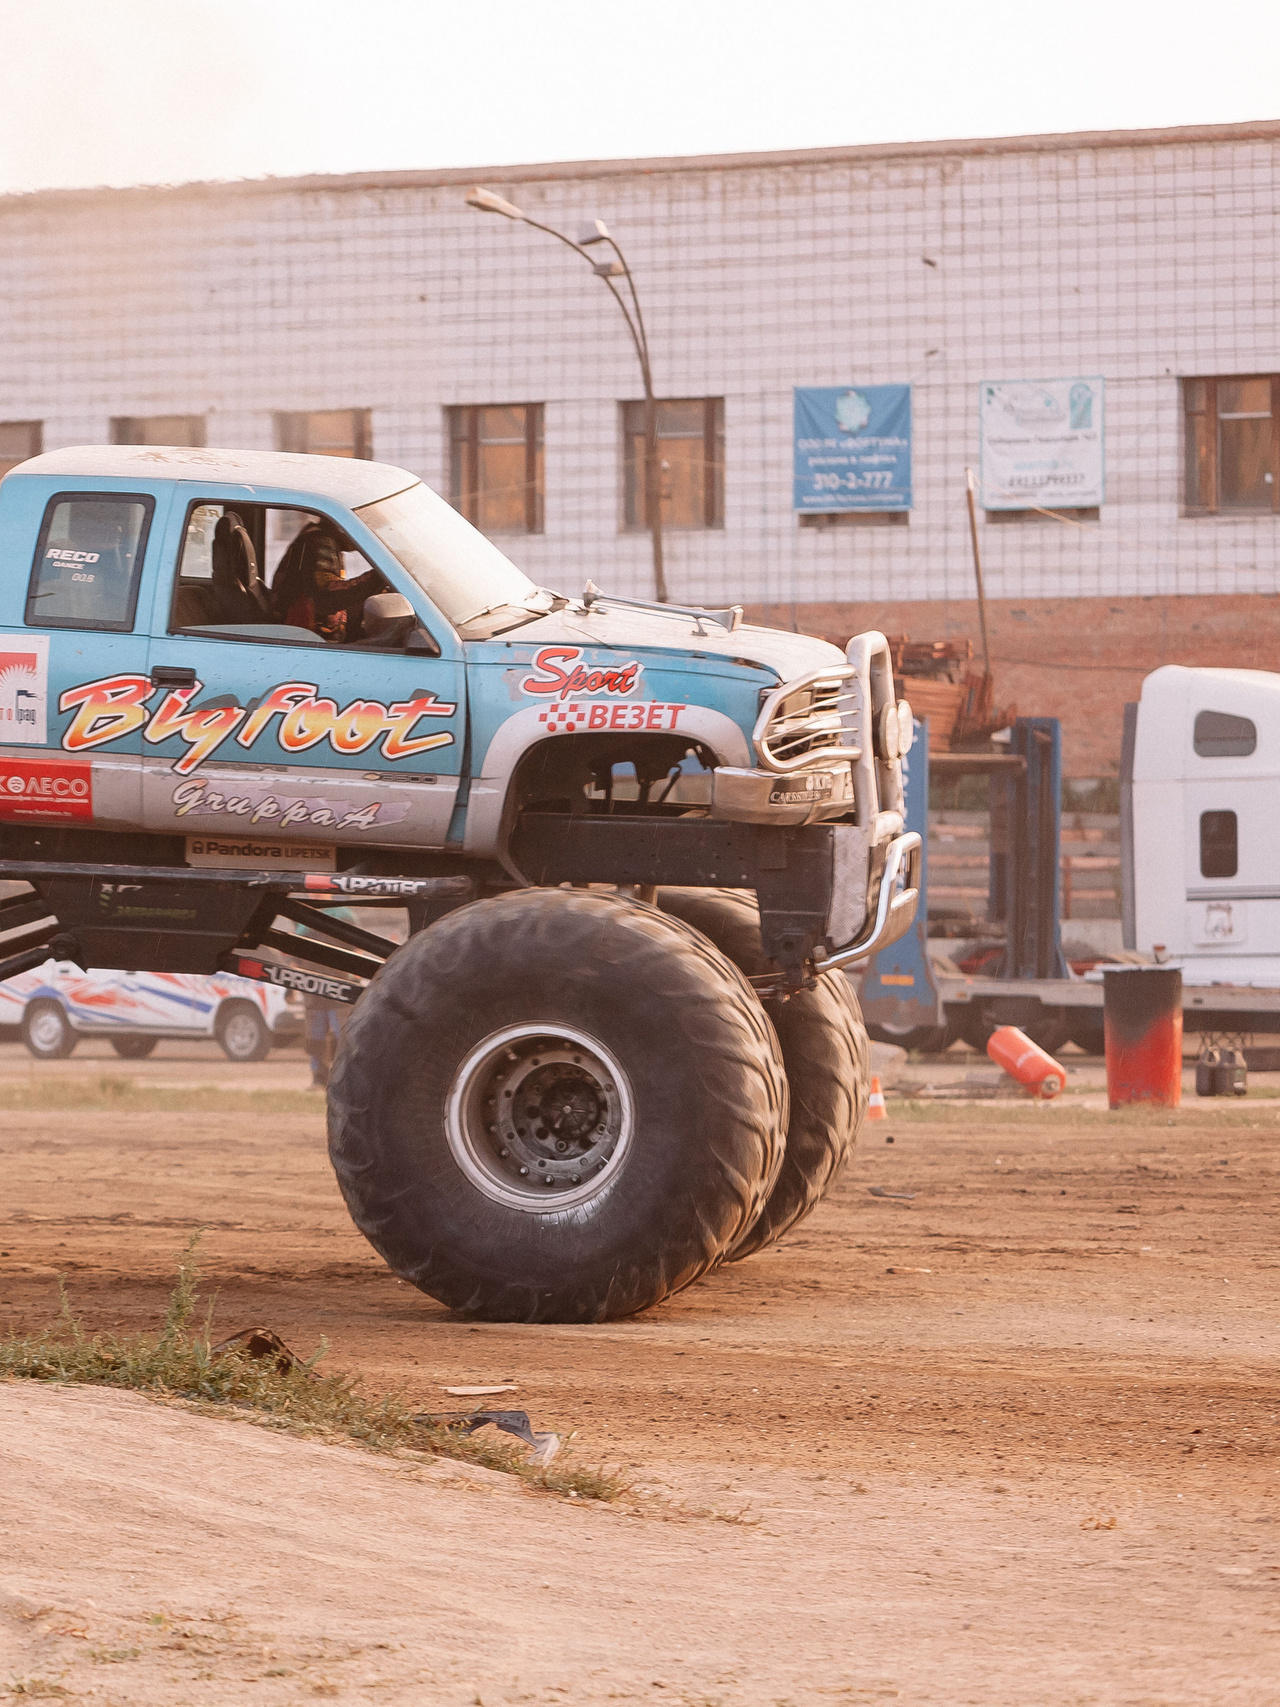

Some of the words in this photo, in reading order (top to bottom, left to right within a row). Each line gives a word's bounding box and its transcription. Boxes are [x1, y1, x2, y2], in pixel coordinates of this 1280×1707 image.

[45, 548, 100, 563] RECO
[523, 647, 640, 700] Sport
[206, 842, 282, 858] Pandora
[284, 847, 332, 859] LIPETSK
